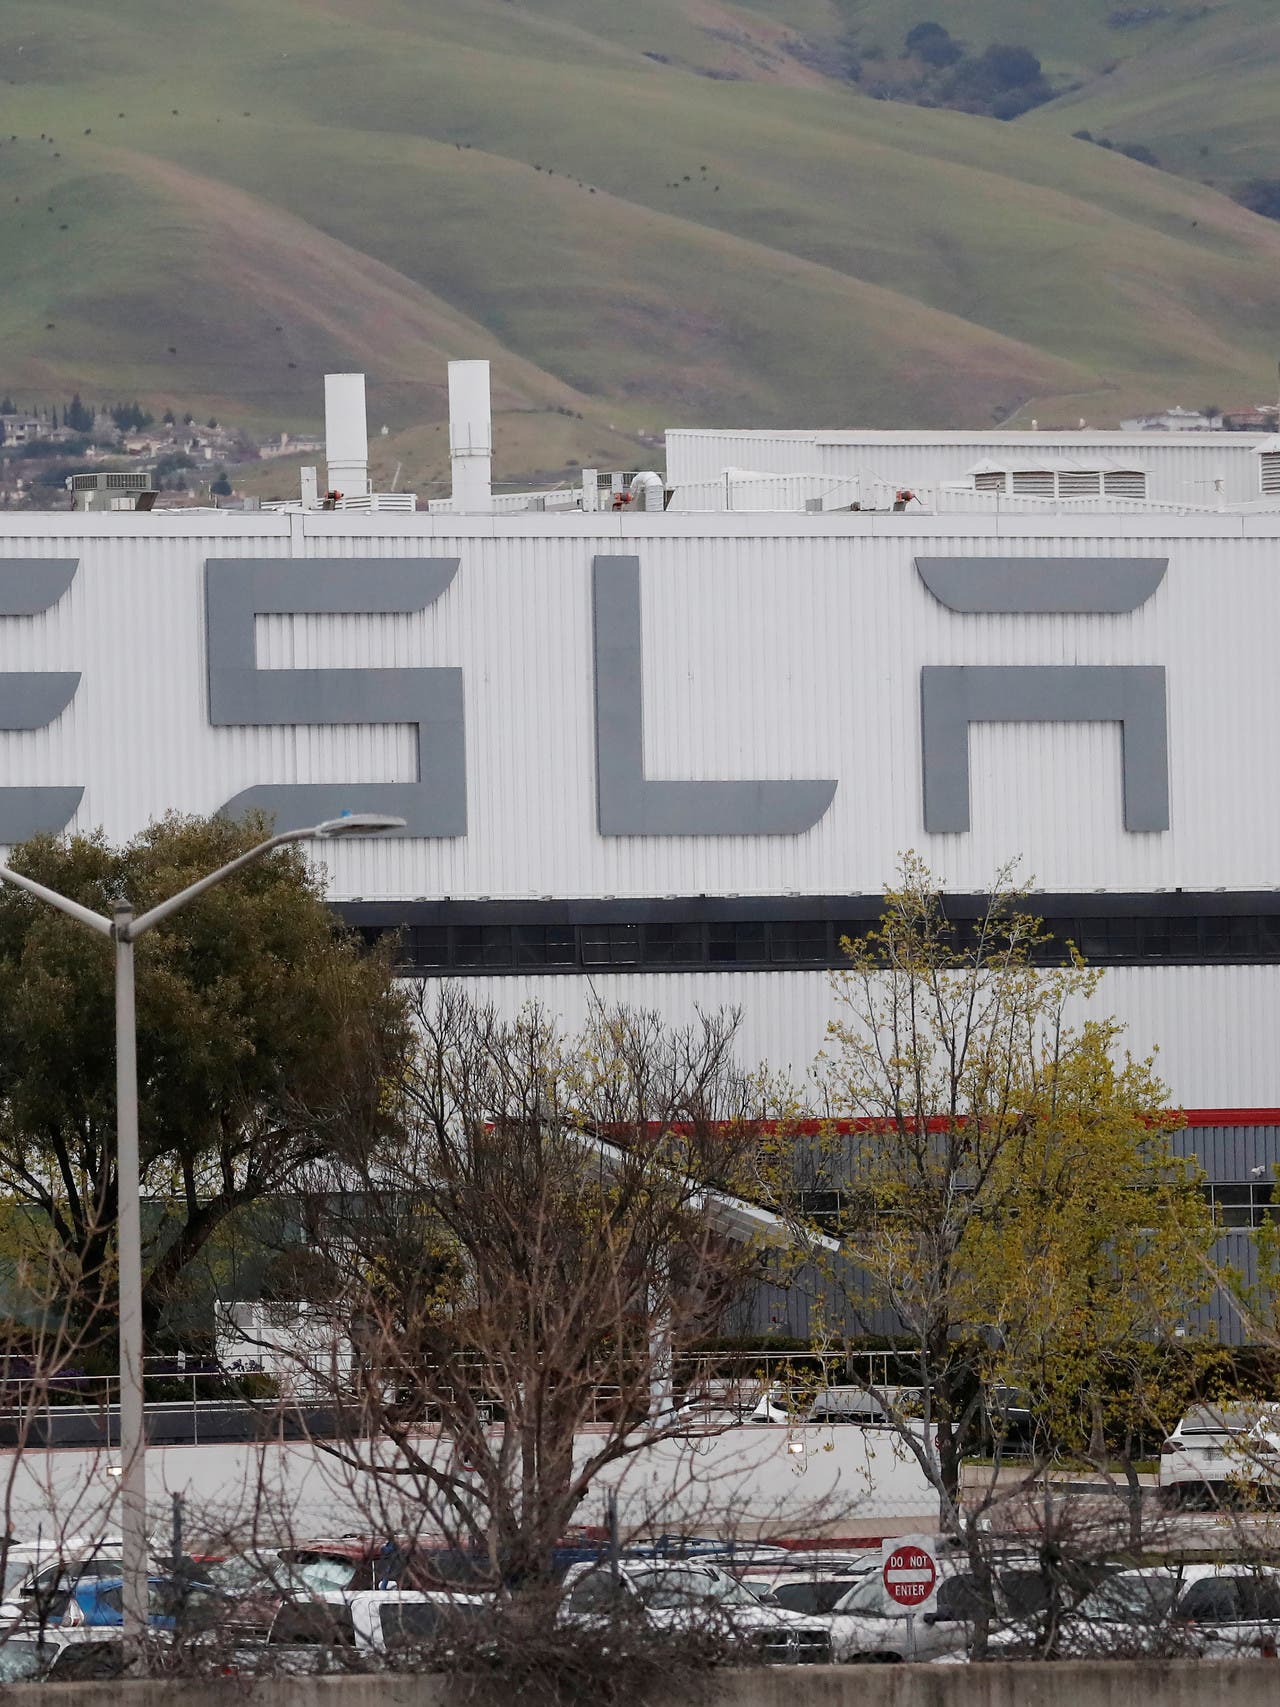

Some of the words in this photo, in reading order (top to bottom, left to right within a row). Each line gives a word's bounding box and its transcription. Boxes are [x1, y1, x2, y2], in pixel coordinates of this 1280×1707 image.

[890, 1556, 904, 1568] DO
[910, 1555, 928, 1568] NOT
[895, 1584, 925, 1596] ENTER
